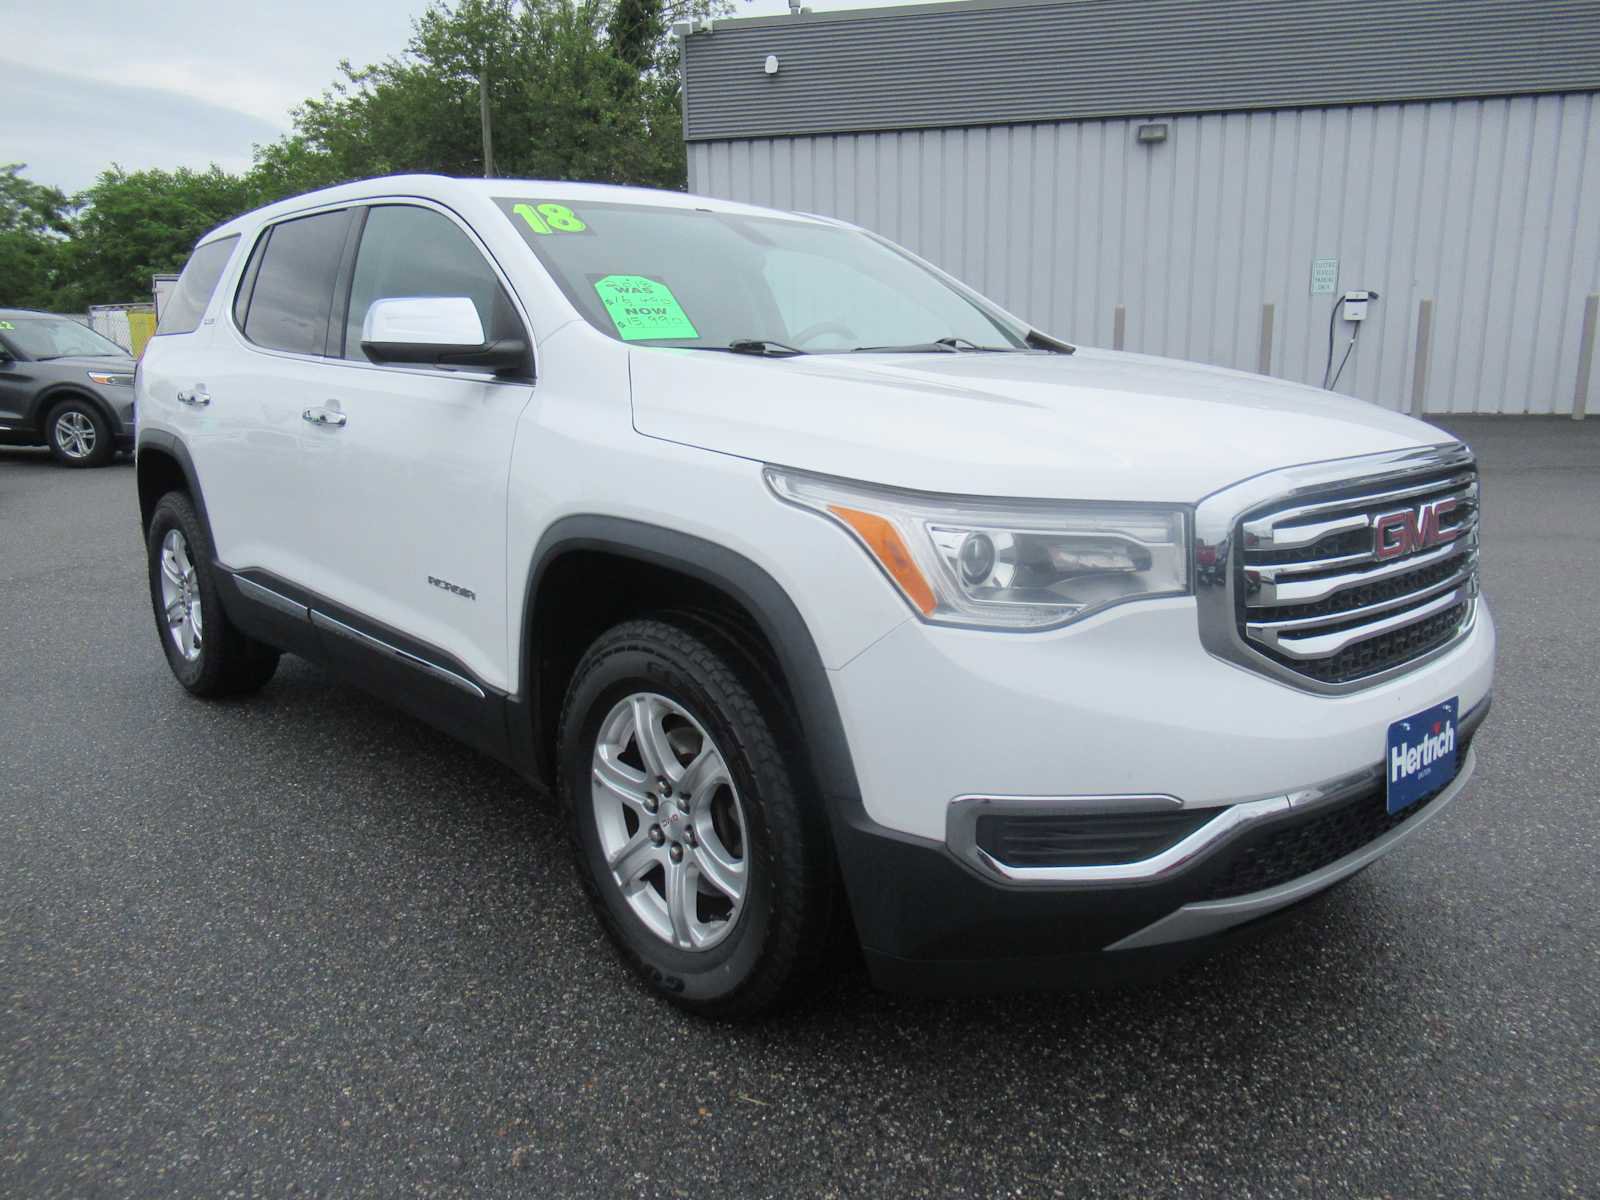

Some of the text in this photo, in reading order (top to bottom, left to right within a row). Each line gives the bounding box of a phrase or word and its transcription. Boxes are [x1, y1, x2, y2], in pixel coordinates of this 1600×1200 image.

[512, 203, 586, 234] 18
[1373, 497, 1457, 562] GMC
[1391, 719, 1454, 783] Hertrich
